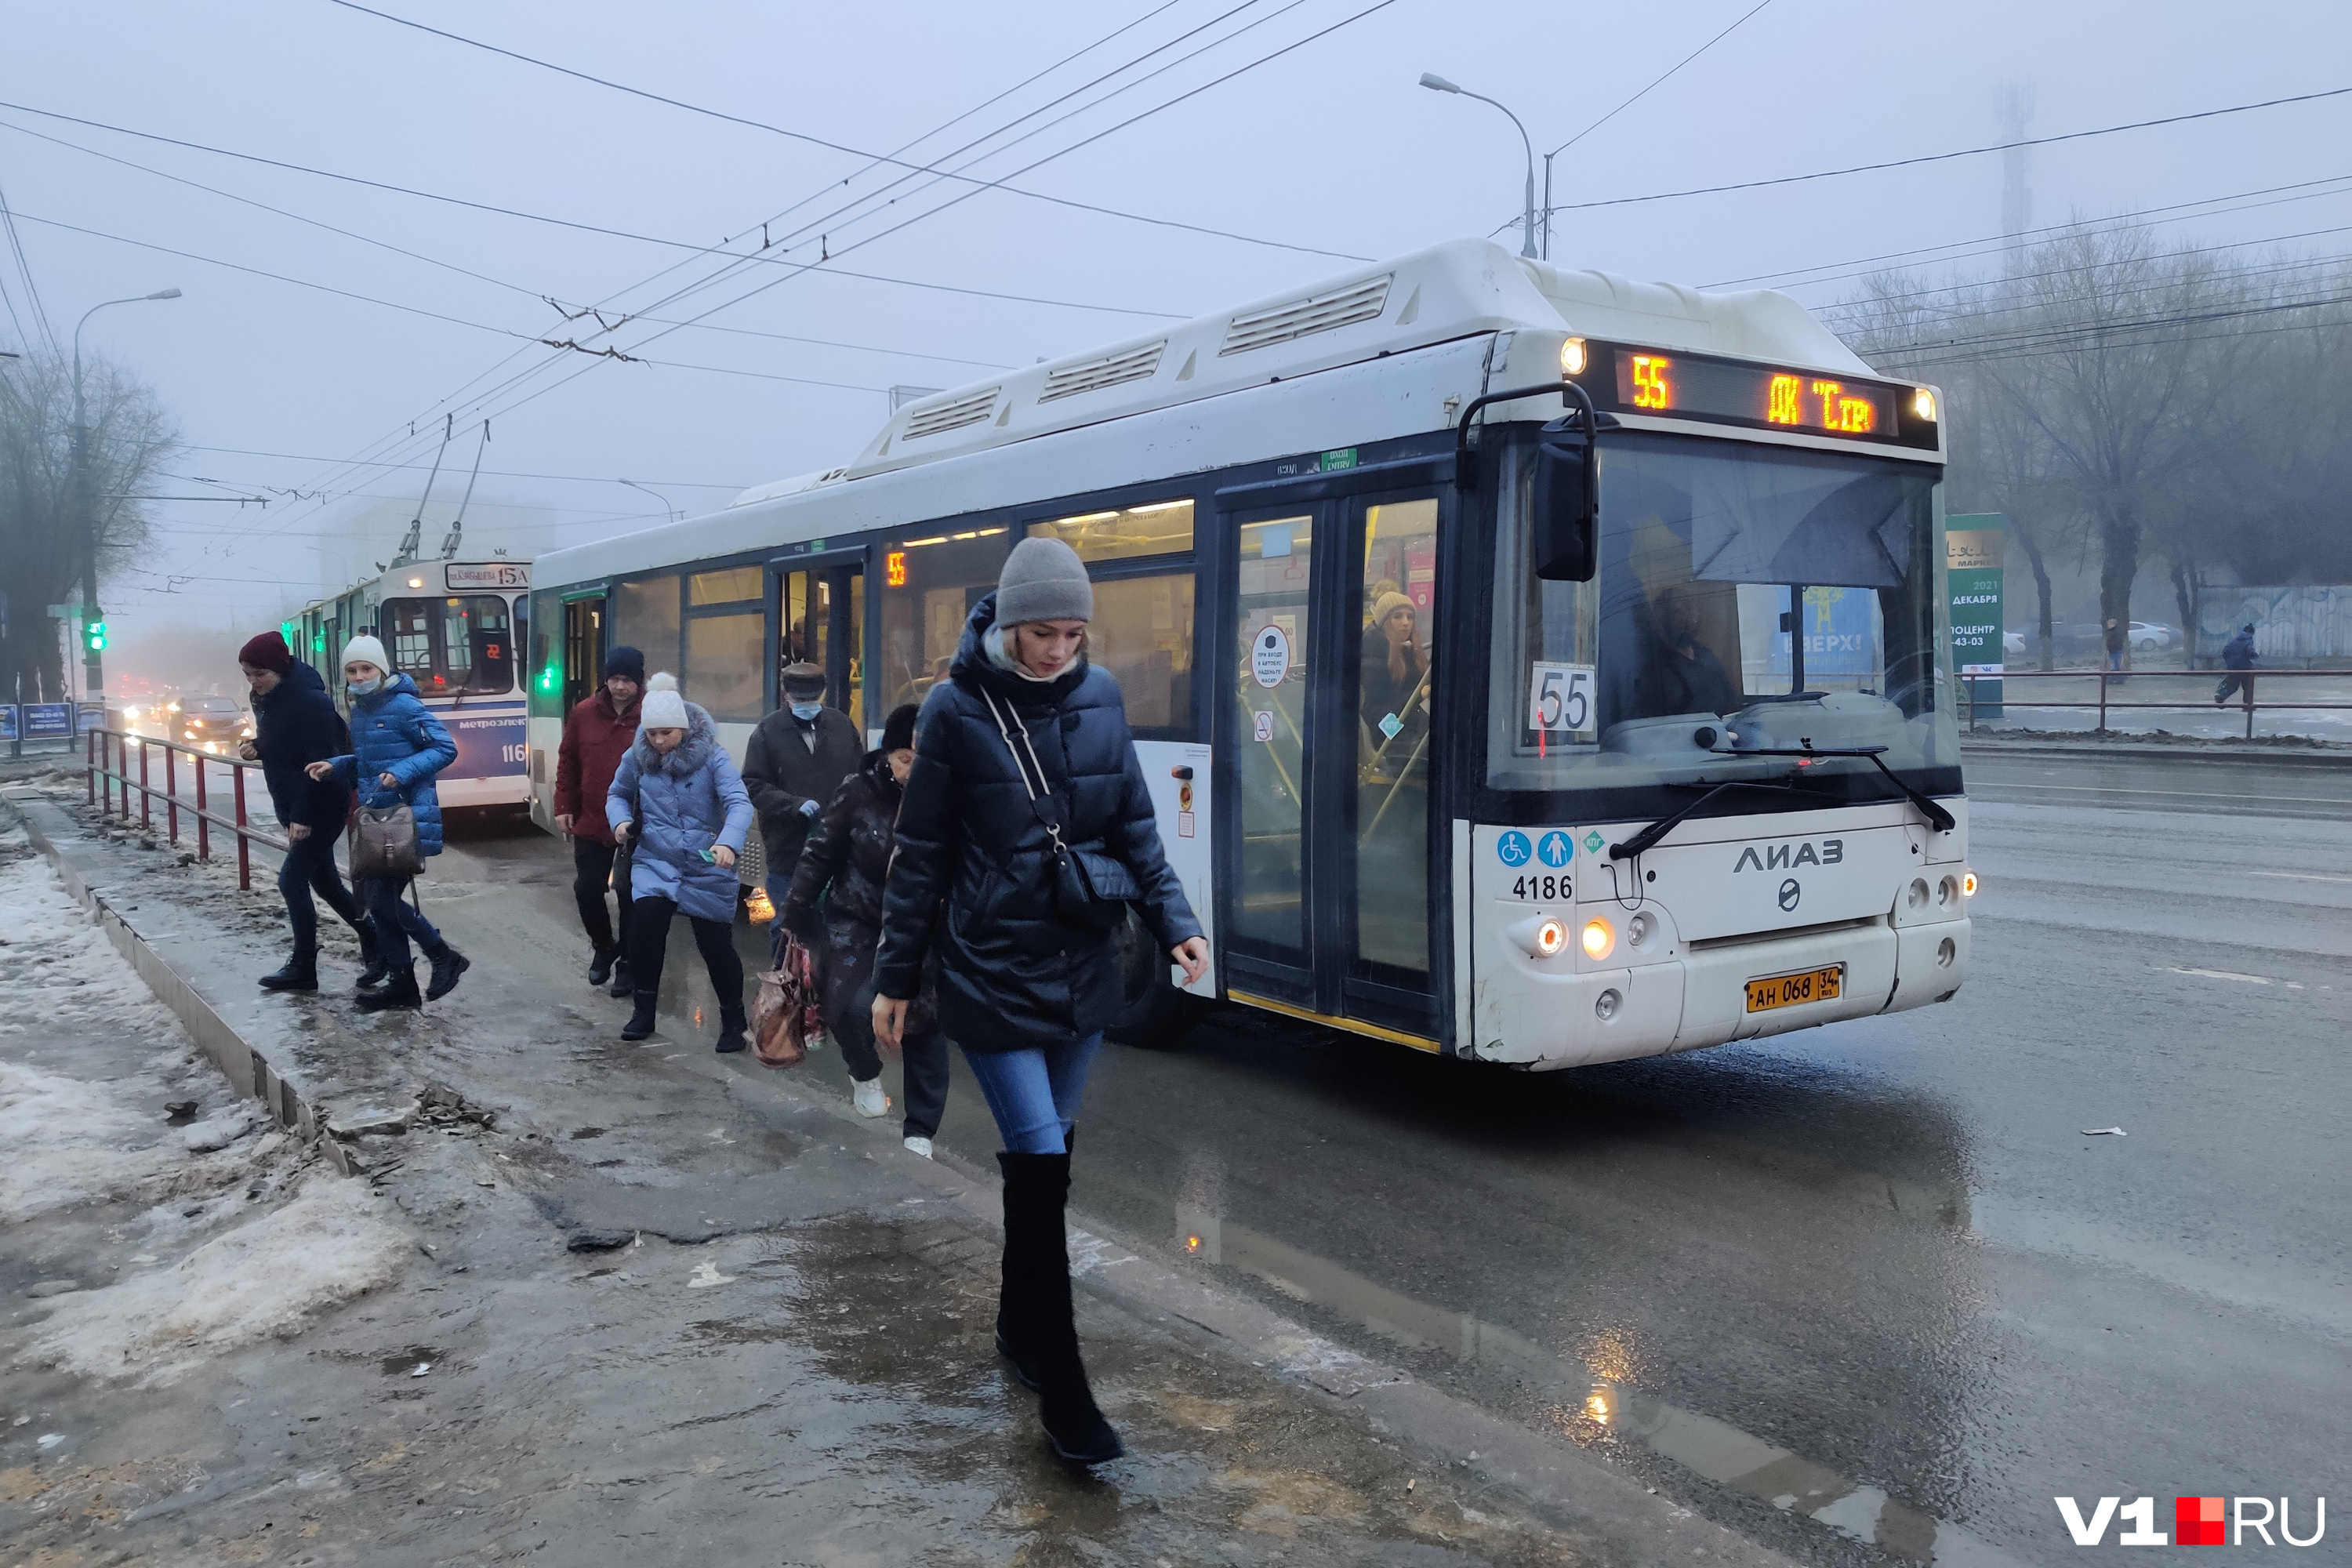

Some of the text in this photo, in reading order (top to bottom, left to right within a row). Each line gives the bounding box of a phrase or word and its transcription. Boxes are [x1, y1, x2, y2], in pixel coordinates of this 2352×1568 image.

[1632, 355, 1667, 409] 55
[1768, 376, 1798, 424] ДК
[1973, 580, 1998, 591] 2021
[1952, 594, 1998, 605] ДЕКАБРЯ
[1950, 625, 1995, 636] ОЦЕНТР
[1951, 637, 1984, 647] -43-03
[1539, 672, 1587, 728] 55
[459, 718, 527, 729] метроэлек
[1586, 837, 1602, 847] КПГ
[1733, 839, 1843, 873] ЛИАЗ
[1513, 875, 1572, 900] 4186
[1783, 977, 1810, 1002] 068
[1820, 971, 1835, 989] 34
